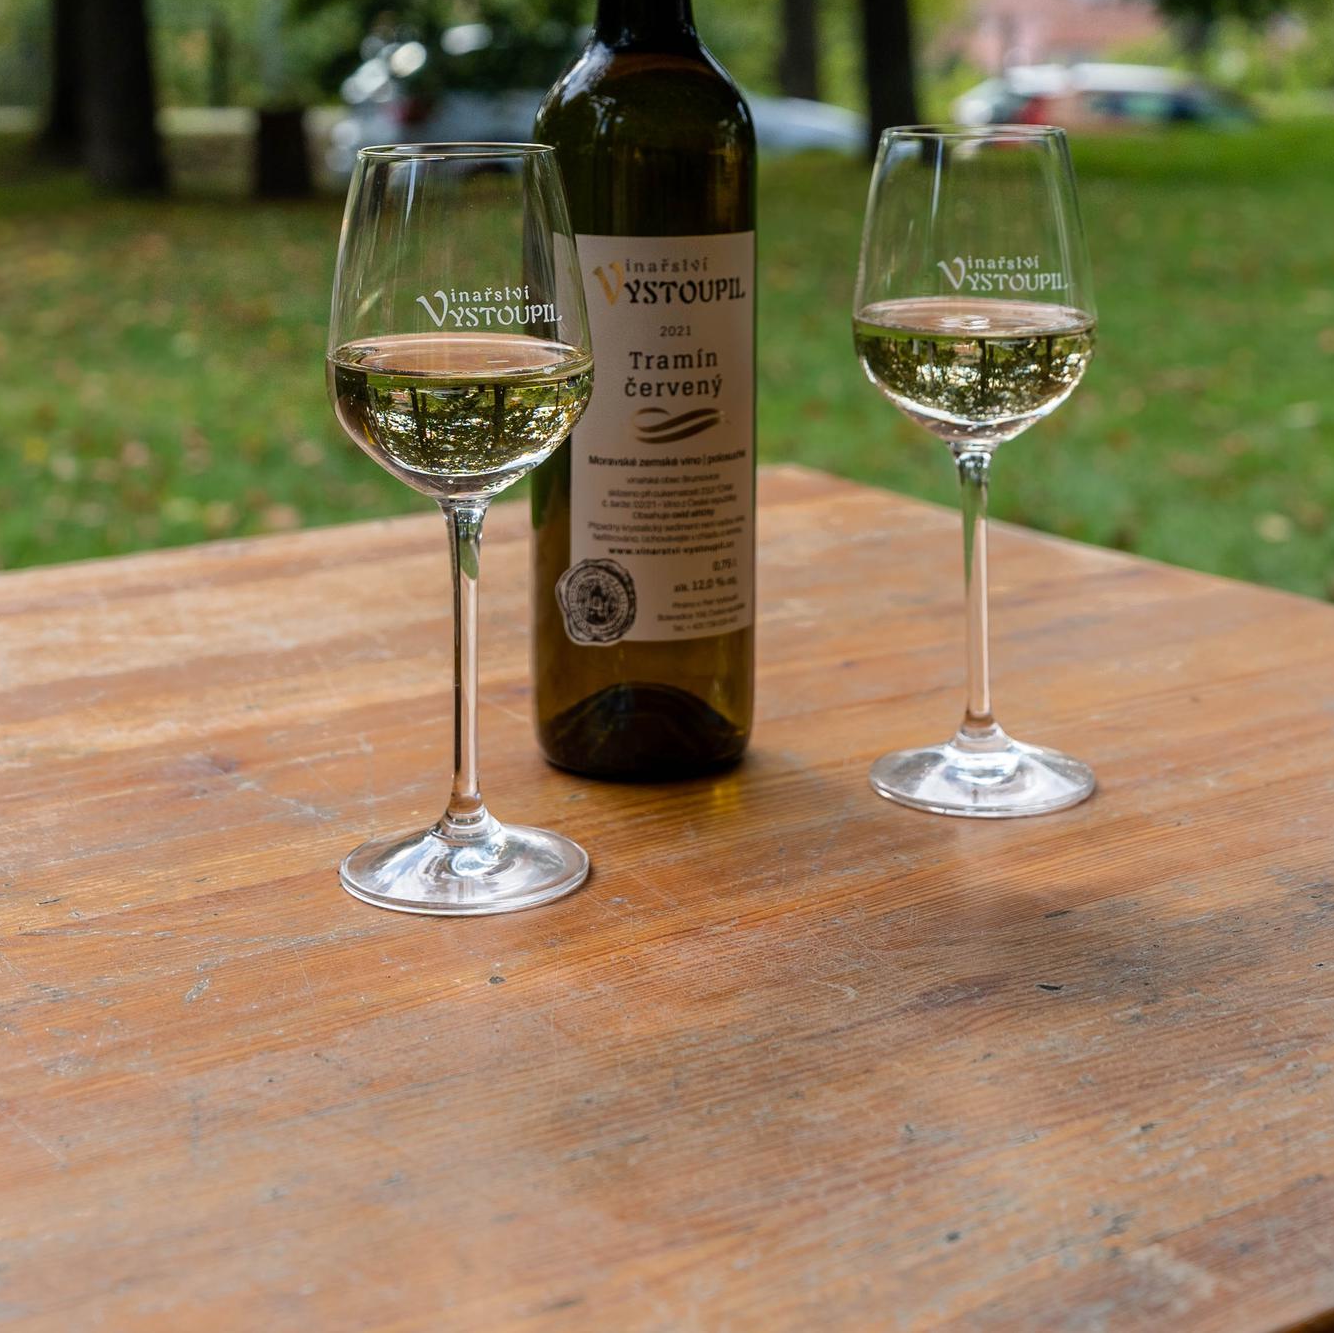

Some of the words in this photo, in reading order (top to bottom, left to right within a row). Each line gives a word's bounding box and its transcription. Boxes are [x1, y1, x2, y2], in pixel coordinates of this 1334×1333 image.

[592, 261, 746, 307] VYSTOUPIL
[937, 257, 1069, 291] VYSTOUPIL
[416, 290, 562, 327] VYSTOUPIL
[660, 325, 692, 337] 2021
[629, 349, 718, 370] Tramín
[624, 374, 723, 398] červený
